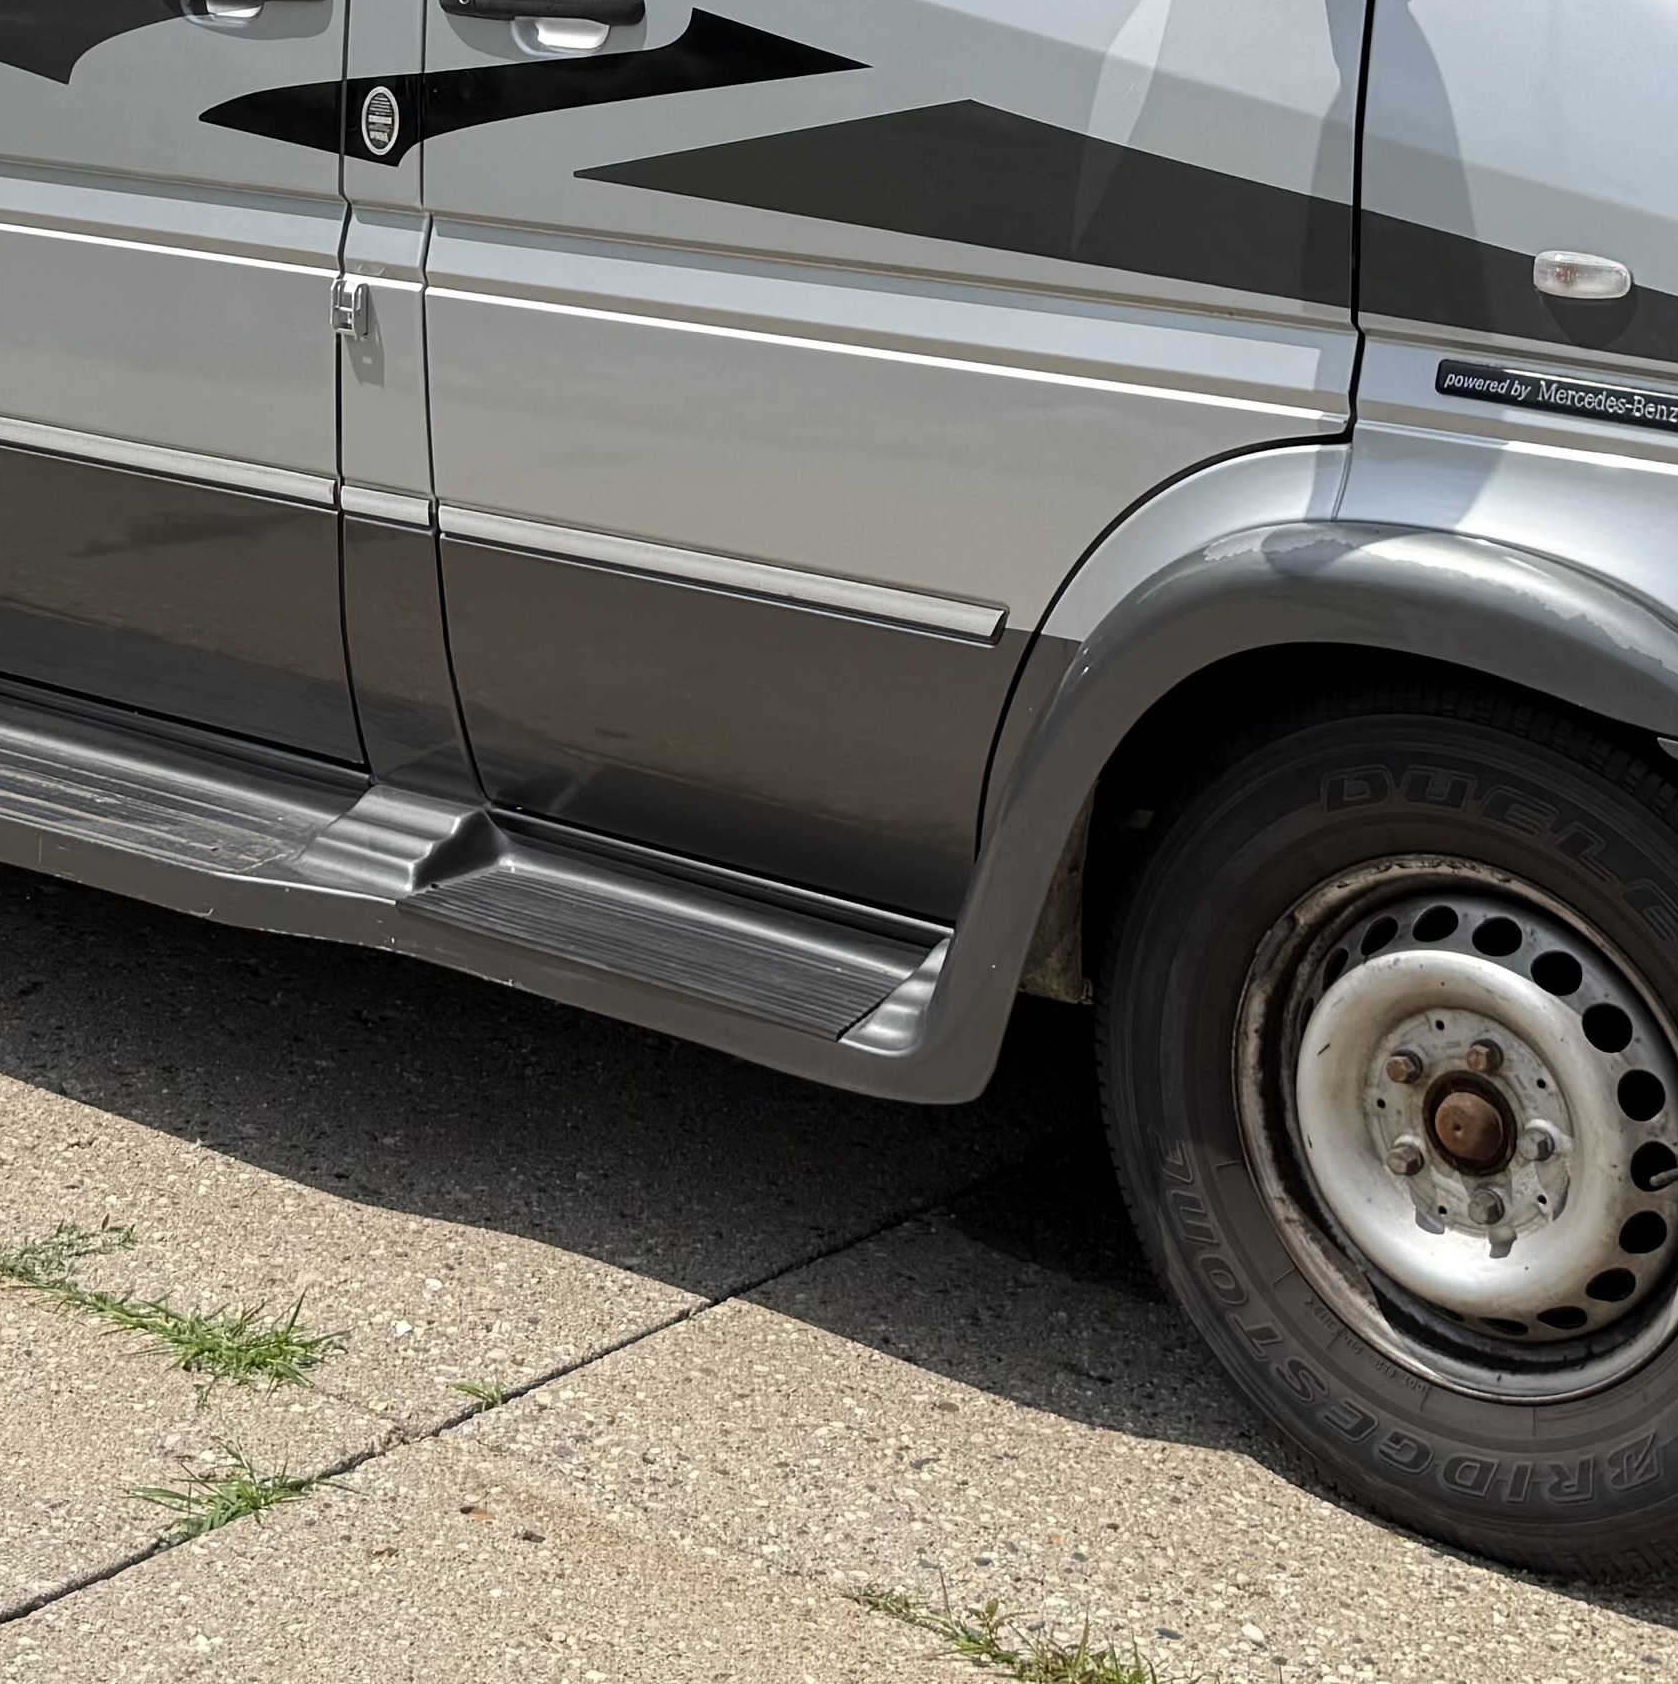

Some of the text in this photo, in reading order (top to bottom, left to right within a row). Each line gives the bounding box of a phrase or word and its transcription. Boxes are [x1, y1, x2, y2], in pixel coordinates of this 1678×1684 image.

[1443, 372, 1510, 394] powered
[1509, 379, 1532, 401] by
[1156, 1131, 1665, 1504] BRIDGESTONE
